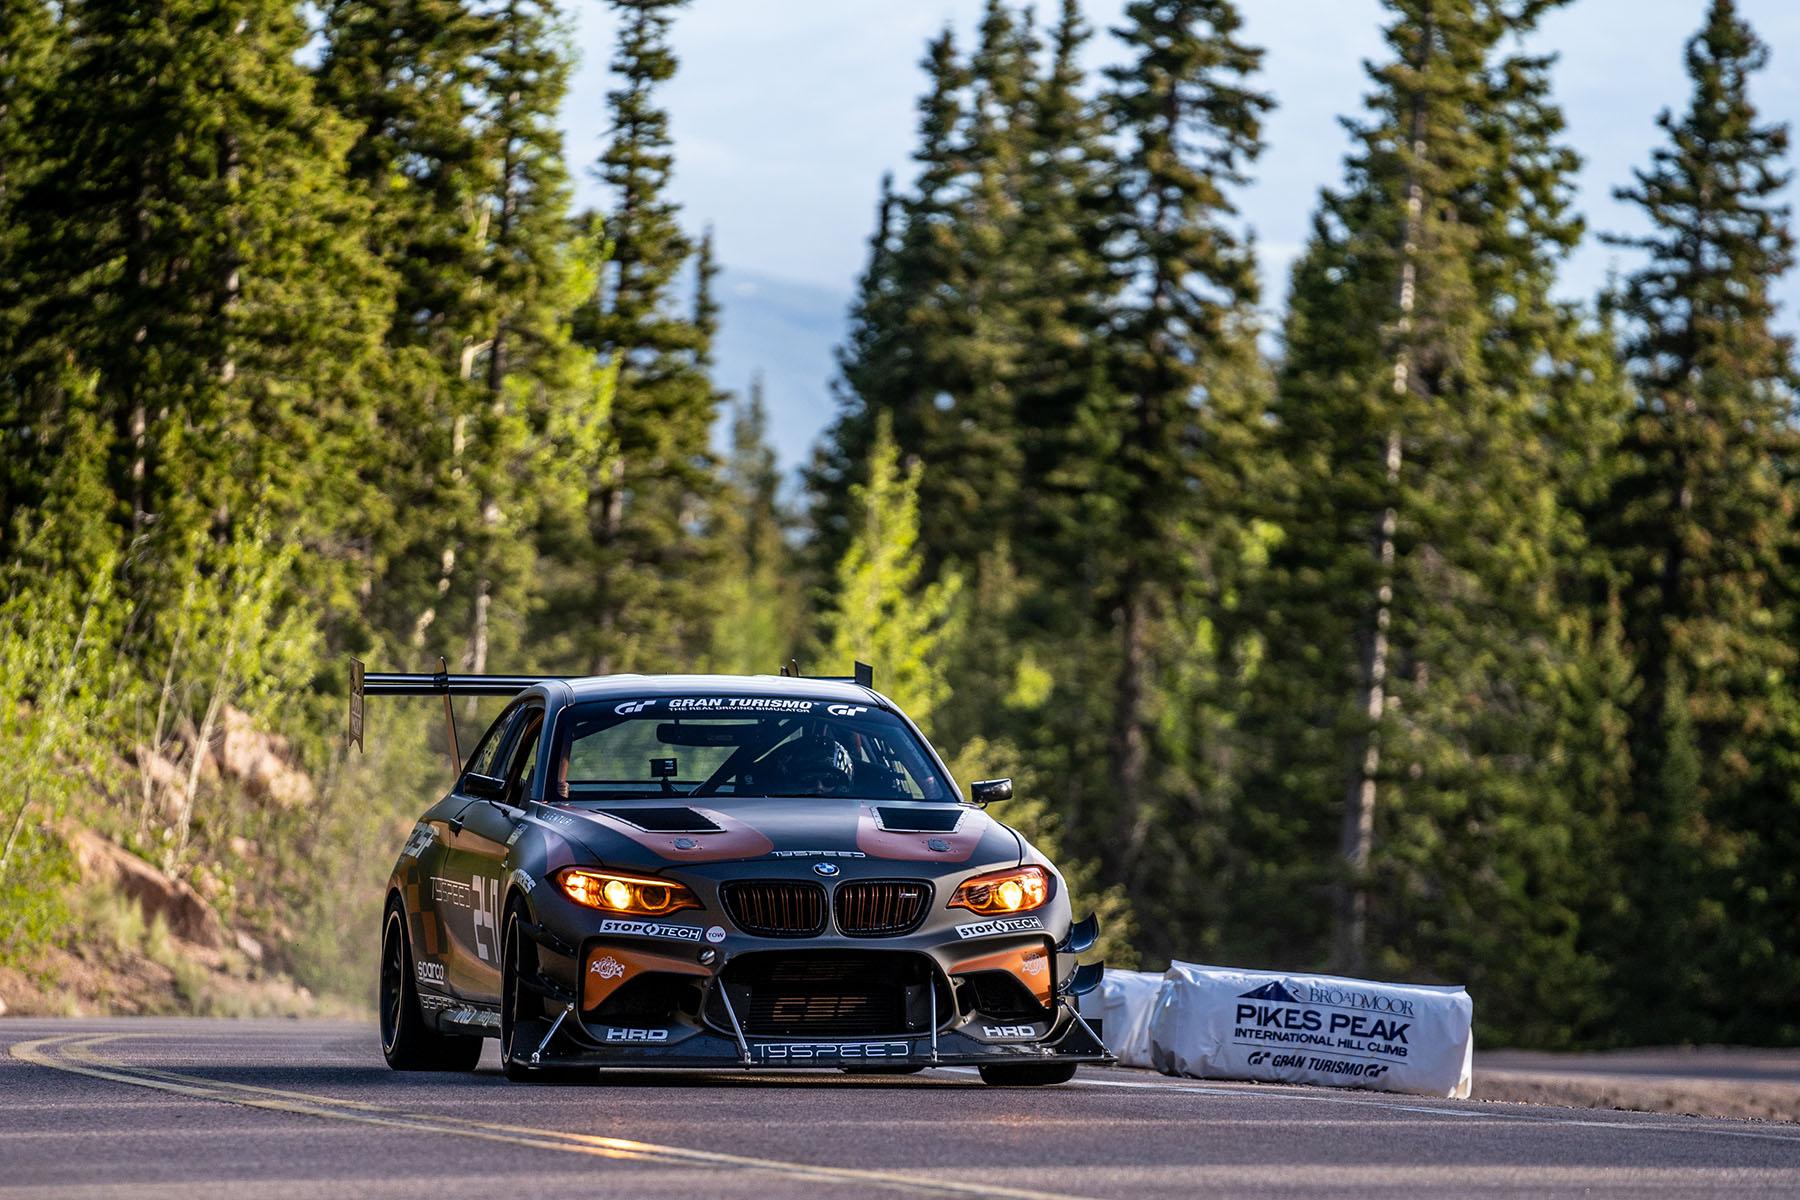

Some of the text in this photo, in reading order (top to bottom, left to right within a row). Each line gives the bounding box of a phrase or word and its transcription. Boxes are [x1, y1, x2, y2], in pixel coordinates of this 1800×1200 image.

[668, 698, 721, 708] GRAN
[728, 698, 812, 709] TURISMO
[708, 931, 725, 939] TOW
[417, 961, 445, 984] sparco
[1309, 987, 1414, 1016] BROADMOOR
[606, 1028, 669, 1040] HRD
[983, 1025, 1036, 1037] HRD
[1235, 1004, 1411, 1044] PIKES PEAK
[754, 1041, 908, 1058] TYSPEED
[1234, 1028, 1408, 1057] INTERNATIONAL HILL CLIMB
[1272, 1054, 1306, 1068] GRAN
[1307, 1057, 1364, 1077] TURISMO
